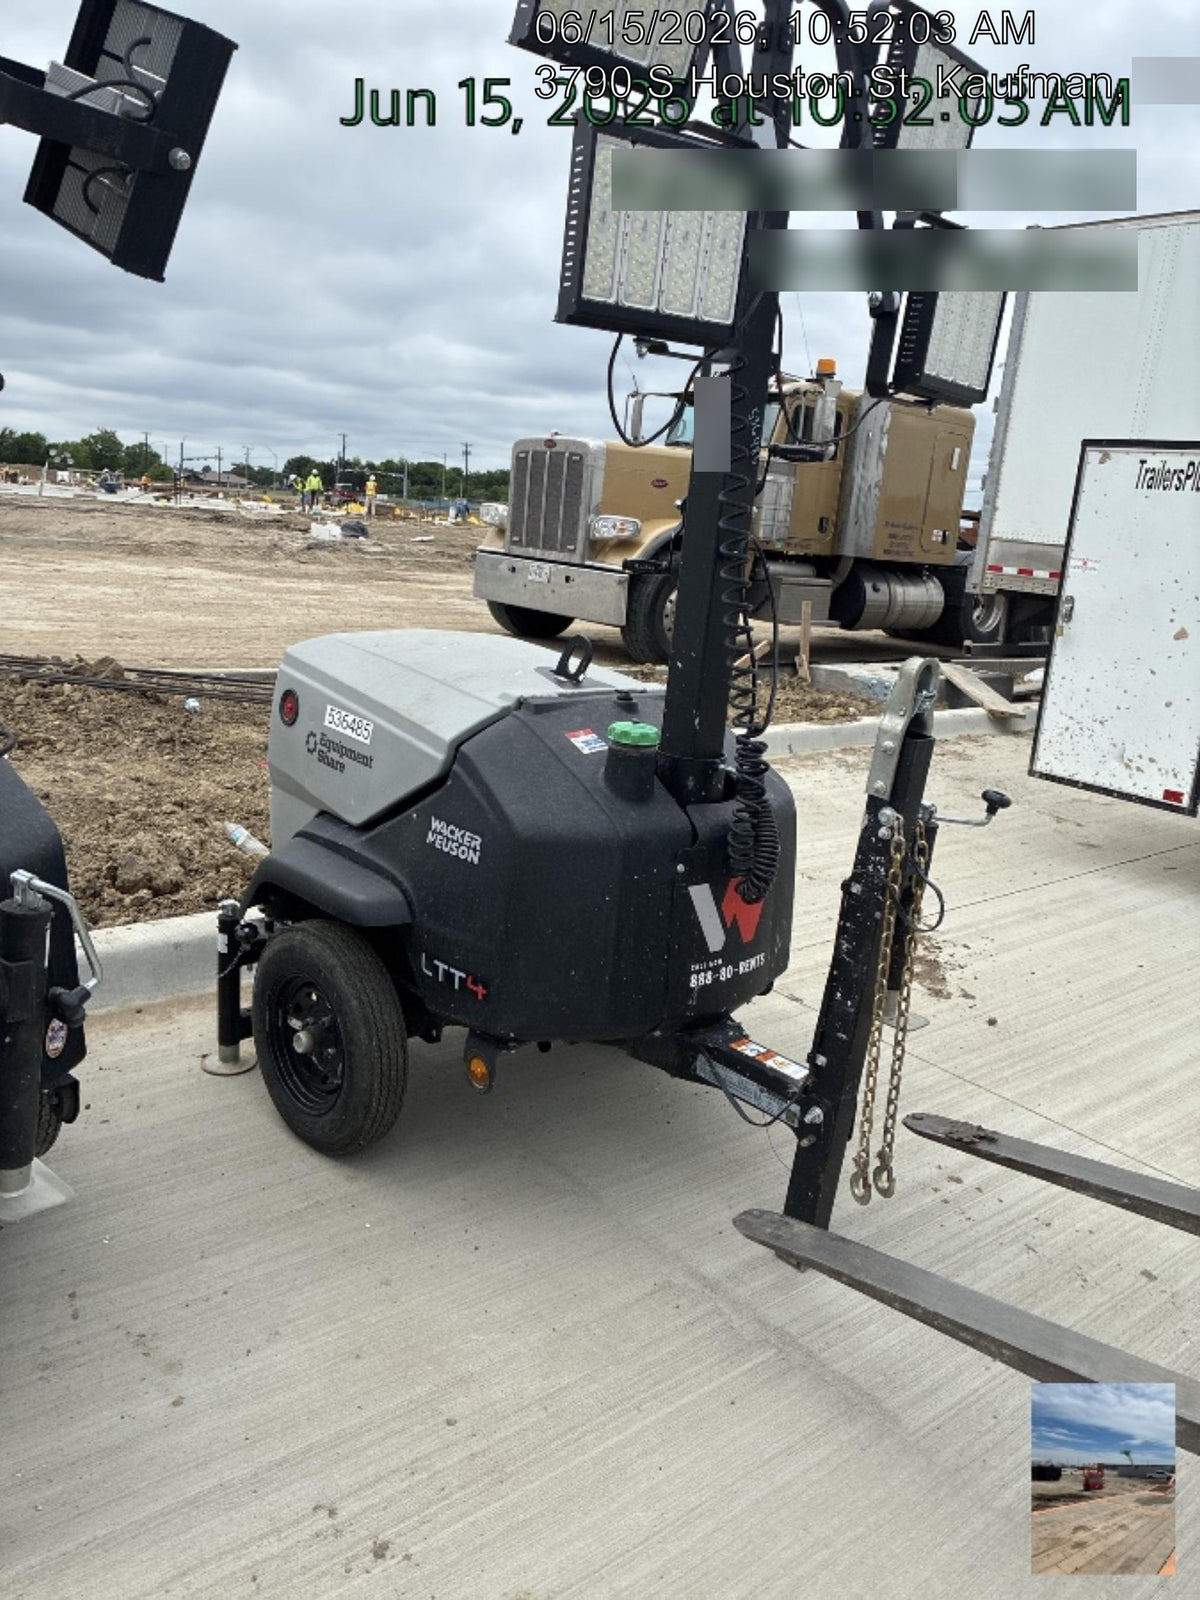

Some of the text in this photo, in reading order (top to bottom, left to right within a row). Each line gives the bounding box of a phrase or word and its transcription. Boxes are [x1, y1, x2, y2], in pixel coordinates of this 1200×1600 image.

[1135, 458, 1200, 492] TrailersPl
[327, 706, 372, 741] 536485
[317, 748, 346, 773] Share
[319, 732, 374, 769] Equipment
[425, 829, 481, 865] NEUSON
[431, 815, 482, 851] WACKER
[421, 952, 488, 1001] LTT4
